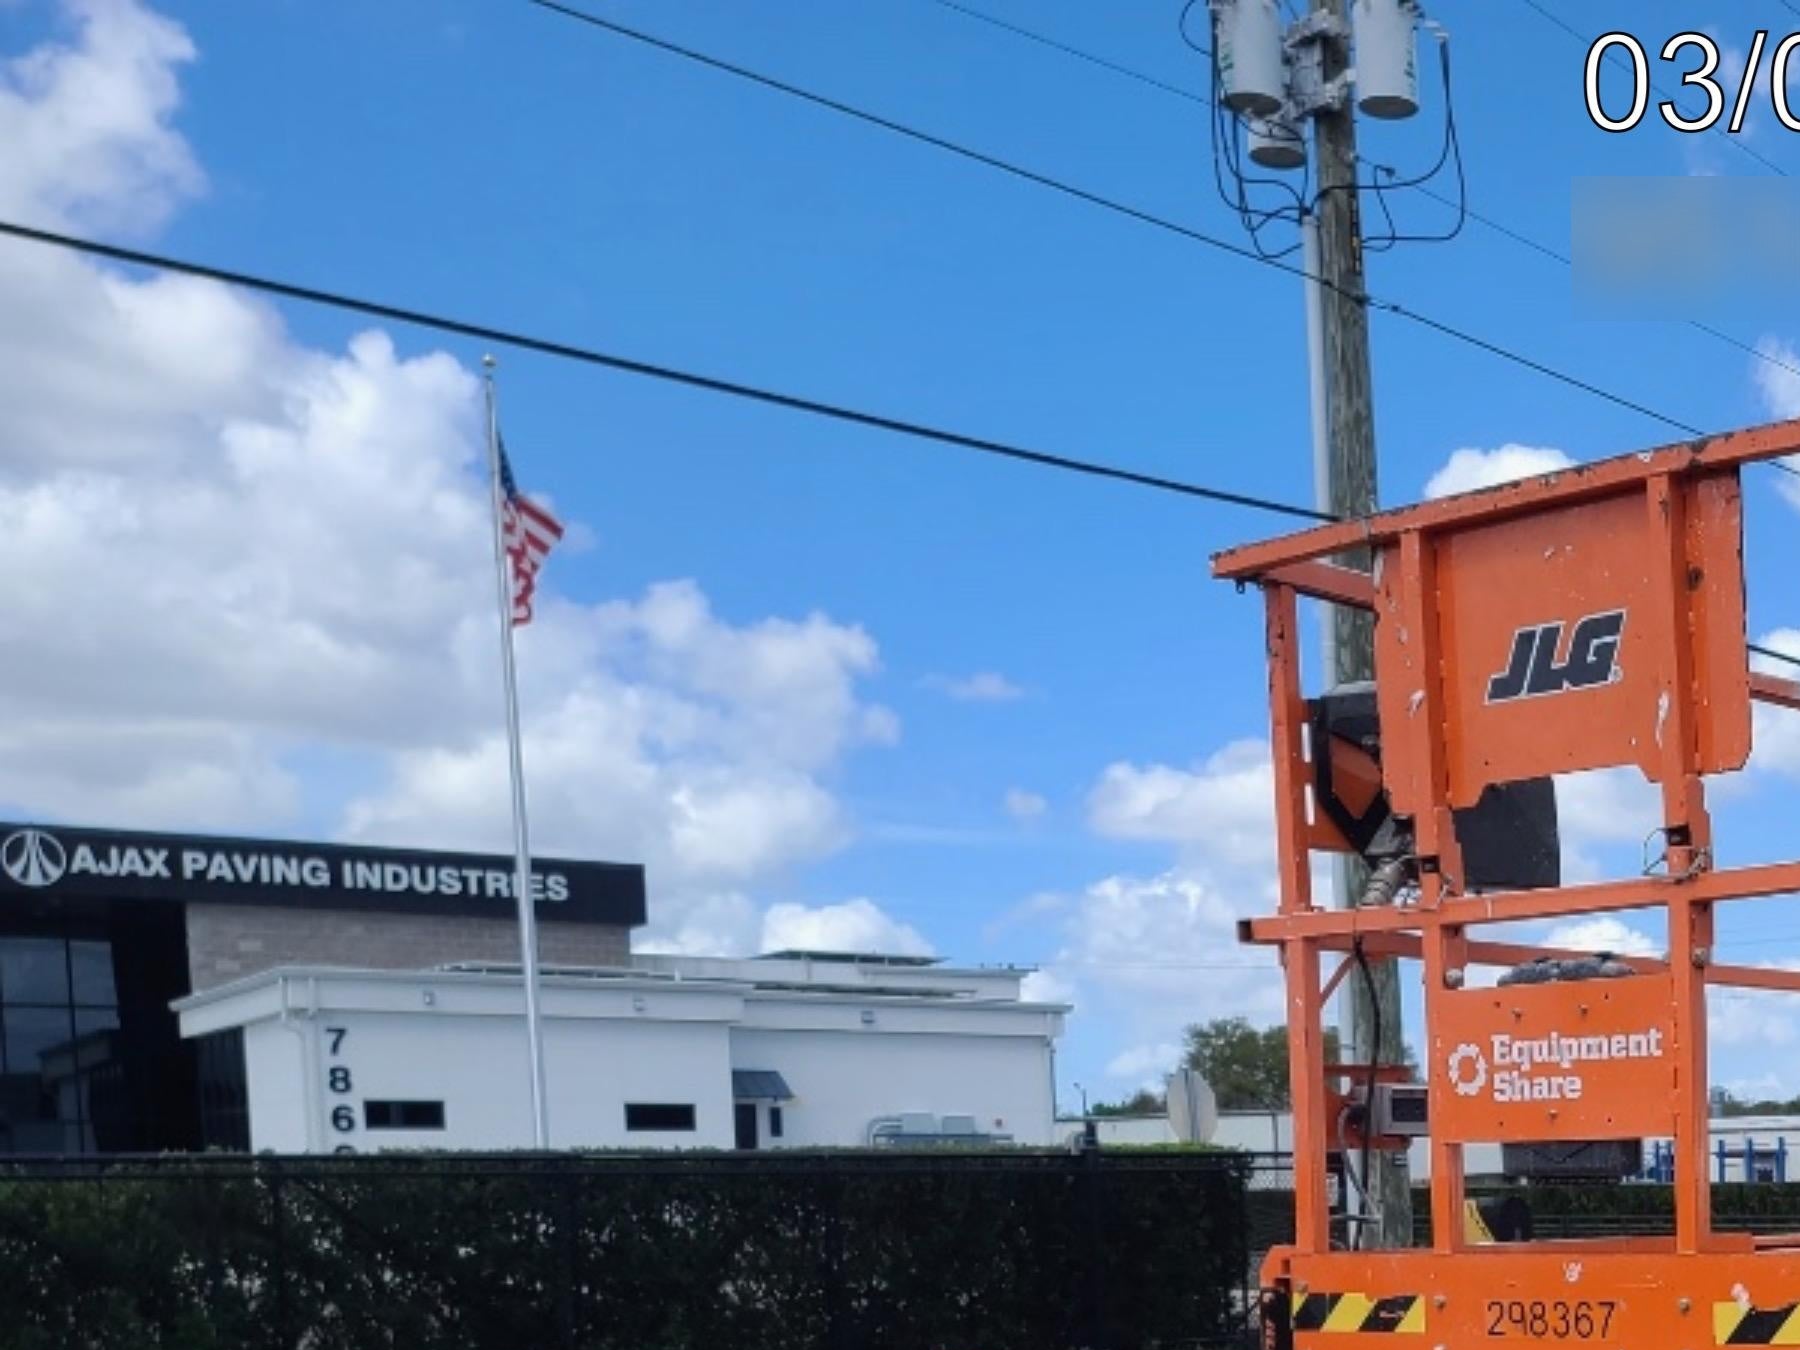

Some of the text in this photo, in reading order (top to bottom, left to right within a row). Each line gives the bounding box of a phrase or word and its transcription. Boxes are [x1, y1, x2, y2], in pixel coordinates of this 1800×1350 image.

[1484, 608, 1627, 706] JLG
[69, 844, 570, 902] AJAX PAVING INDUSTRIES
[1490, 1027, 1663, 1072] Equipment
[1493, 1070, 1583, 1103] Share
[1486, 1300, 1617, 1339] 298367
